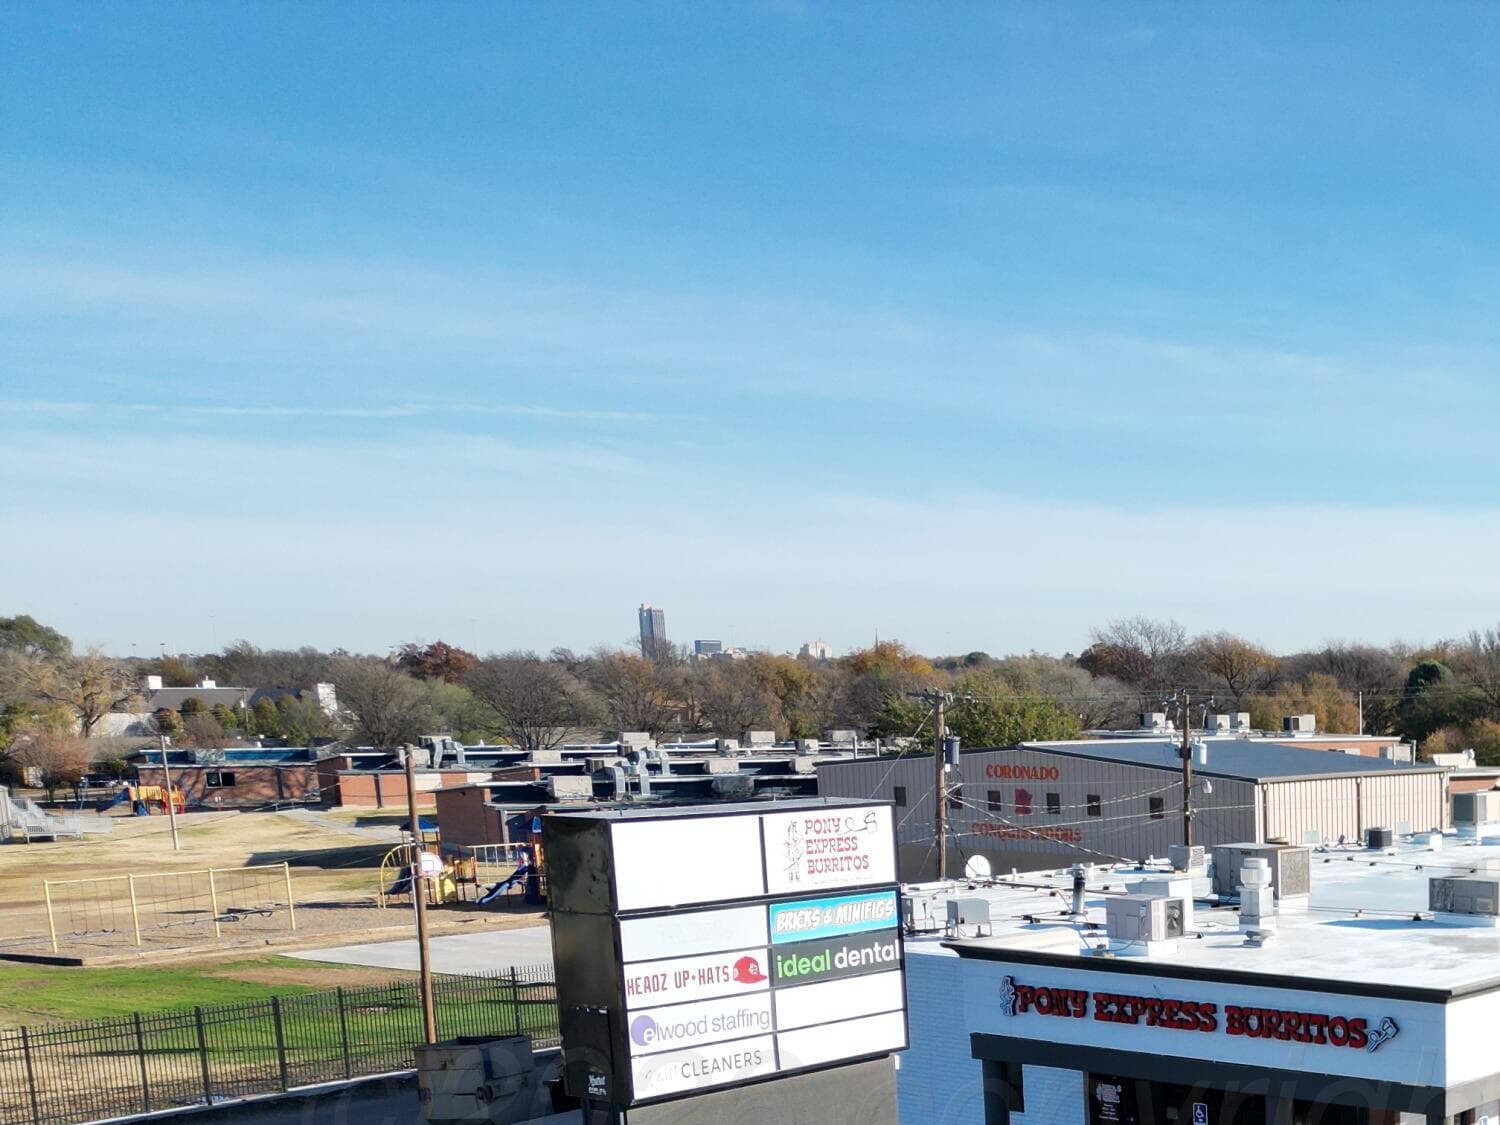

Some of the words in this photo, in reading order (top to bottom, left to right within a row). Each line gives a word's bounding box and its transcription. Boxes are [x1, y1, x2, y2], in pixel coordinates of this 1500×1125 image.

[985, 764, 1059, 781] CORONADO
[804, 817, 841, 835] PONY
[805, 836, 858, 855] EXPRESS
[807, 855, 869, 874] BURRITOS
[776, 907, 821, 932] BRICKS
[831, 897, 895, 925] MINIFIGS
[776, 949, 831, 978] ideal
[834, 938, 900, 969] dental
[626, 973, 668, 996] HEADZ
[643, 1016, 708, 1044] elwood
[711, 1008, 770, 1030] staffing
[1015, 985, 1089, 1019] PONY
[1093, 992, 1218, 1033] EXPRESS
[1224, 1004, 1369, 1050] BURRITOS
[681, 1050, 762, 1079] CLEANERS
